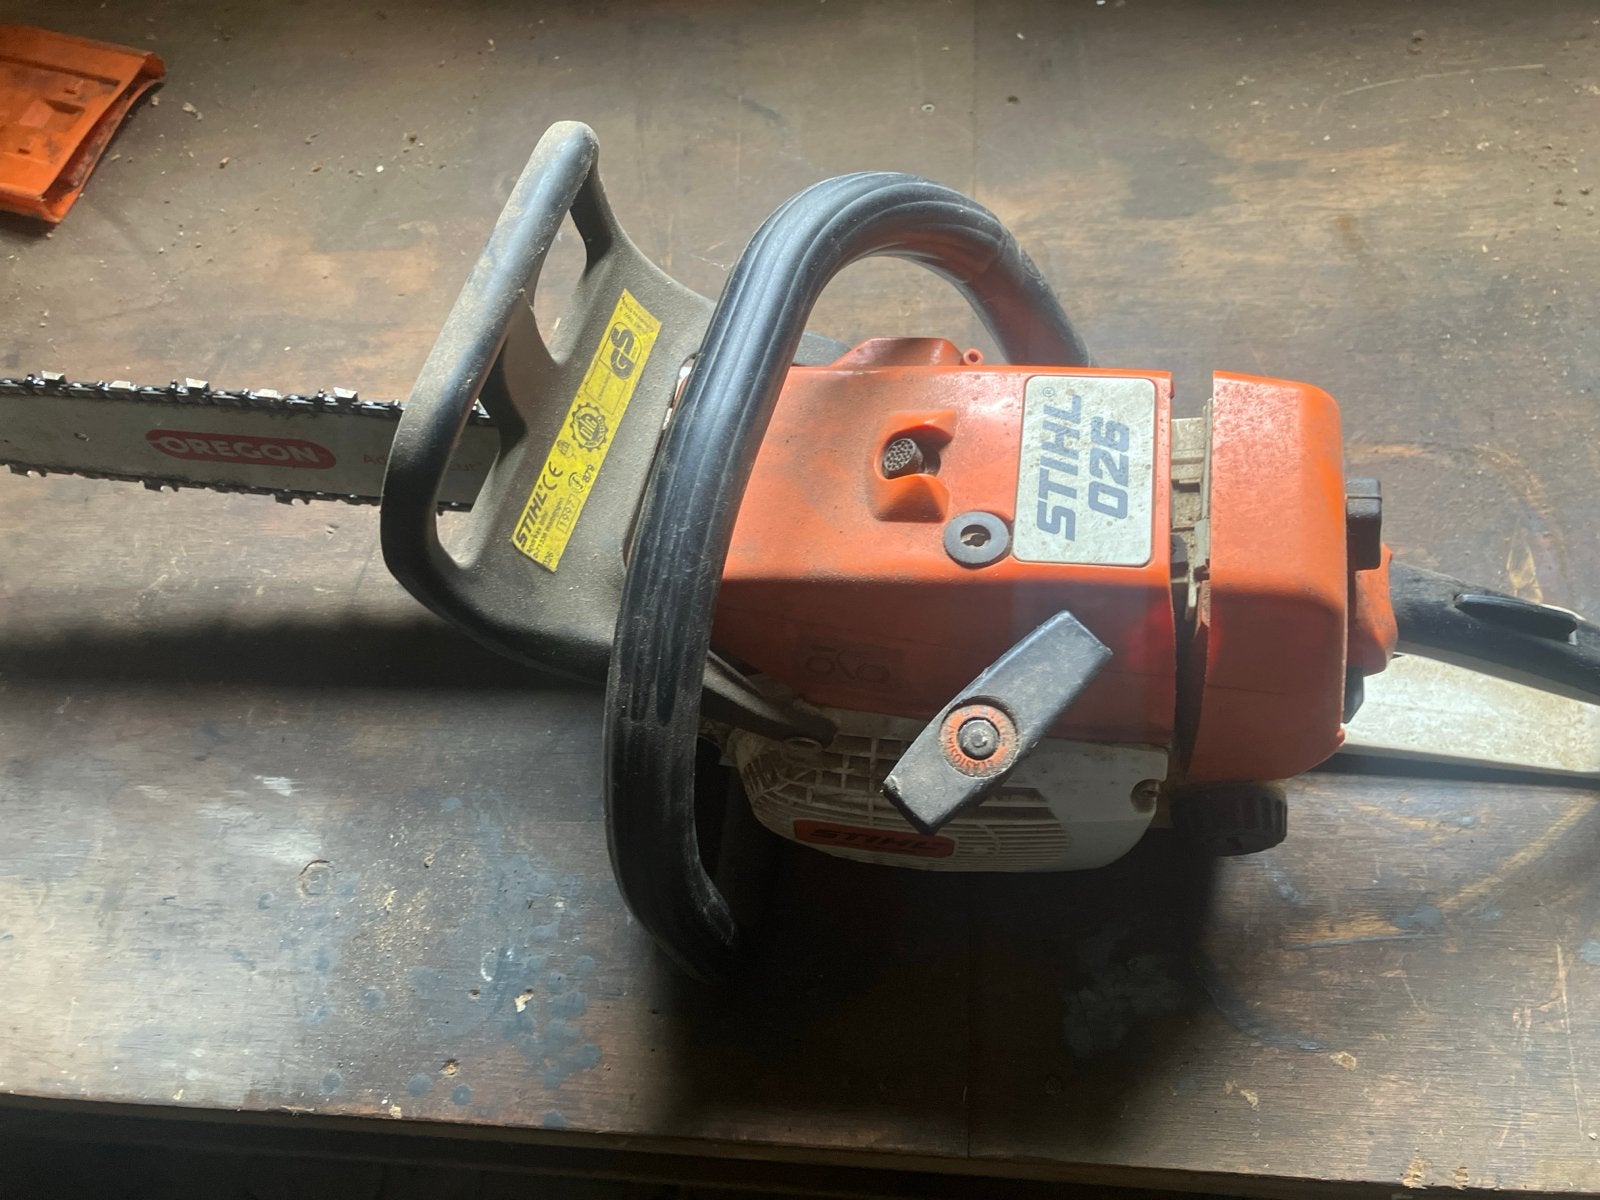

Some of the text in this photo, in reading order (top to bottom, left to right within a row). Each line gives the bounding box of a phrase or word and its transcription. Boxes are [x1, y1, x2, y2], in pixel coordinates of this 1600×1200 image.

[157, 435, 320, 463] OREGON
[1036, 394, 1082, 542] STIHL
[1087, 415, 1130, 520] 026
[515, 491, 548, 549] STIHL
[559, 499, 578, 529] 1997
[810, 828, 937, 850] STIHL
